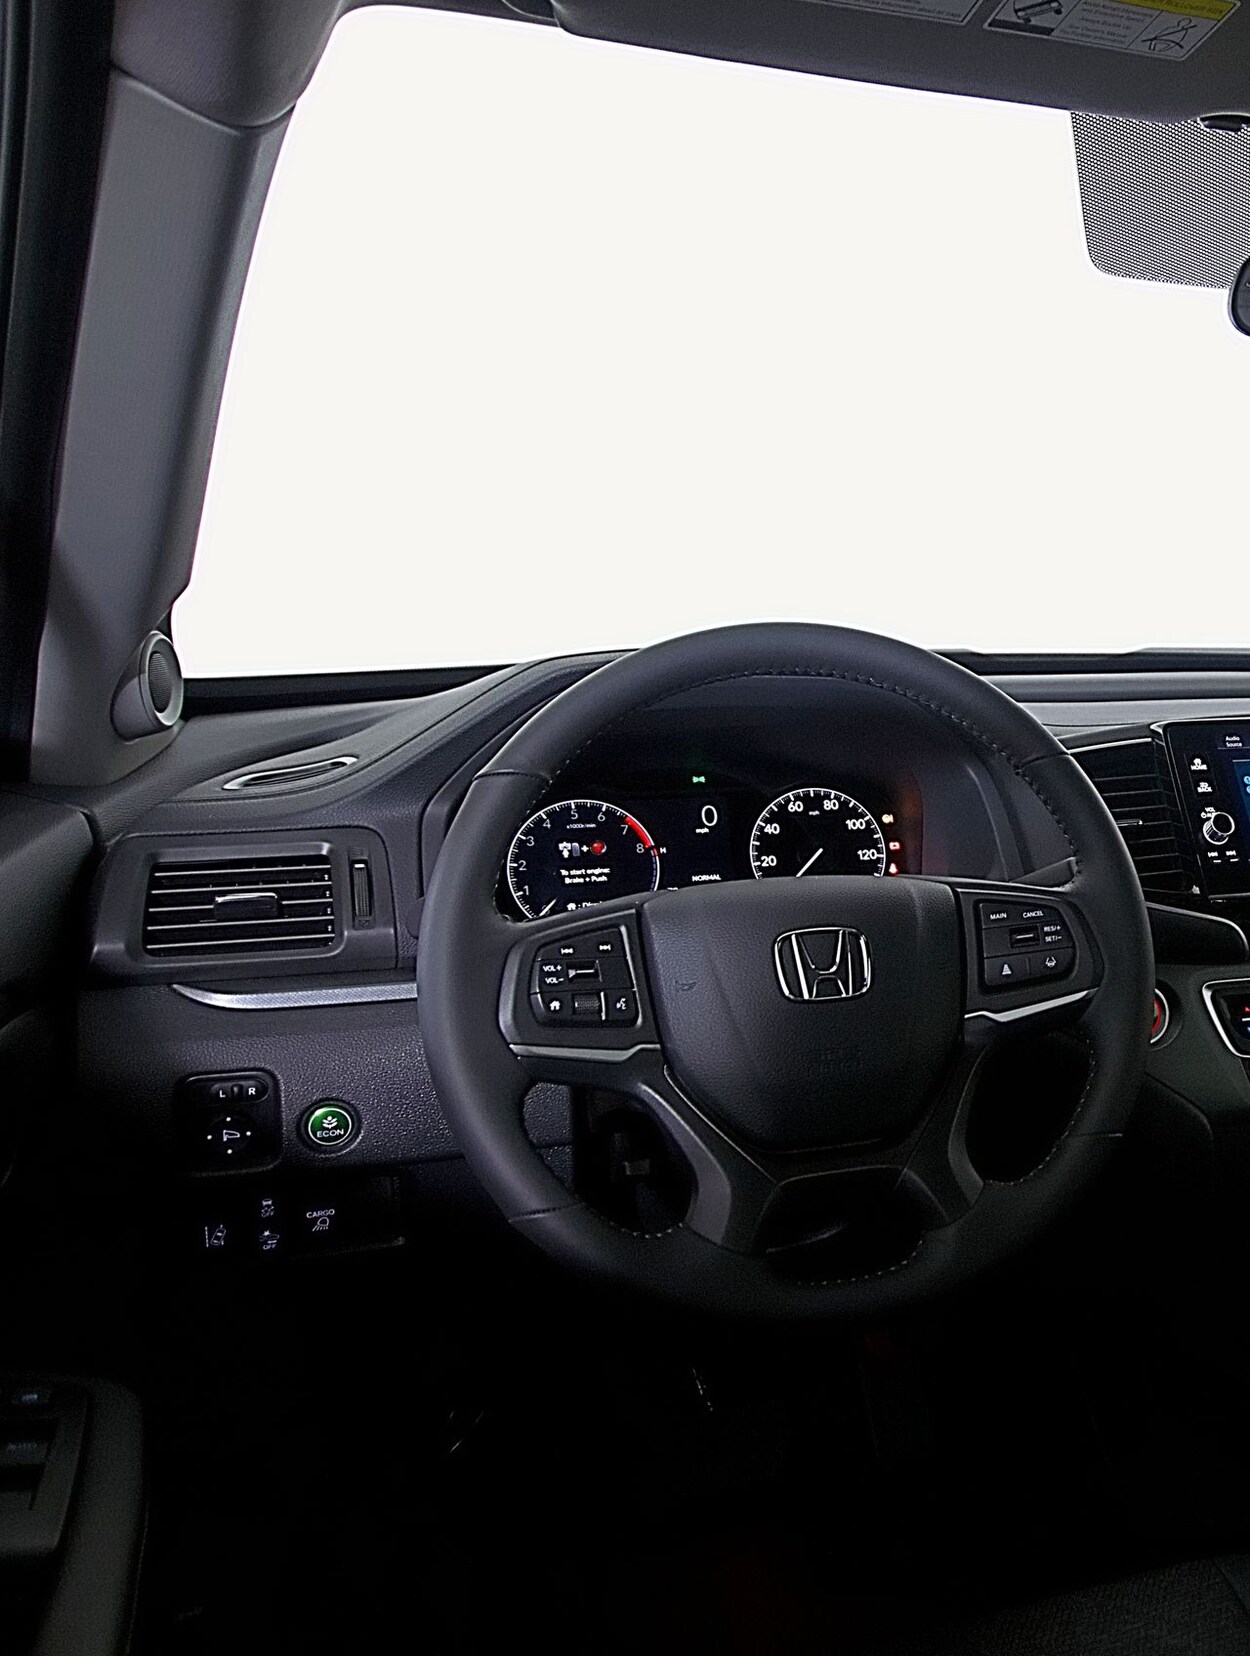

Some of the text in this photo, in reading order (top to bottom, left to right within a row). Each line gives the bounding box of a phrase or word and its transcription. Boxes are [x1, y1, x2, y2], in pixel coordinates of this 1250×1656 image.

[787, 801, 804, 813] 60
[823, 799, 840, 811] 80
[571, 810, 579, 820] 5
[597, 812, 606, 822] 6
[702, 805, 718, 826] 0
[542, 818, 552, 829] 4
[764, 823, 781, 835] 40
[845, 819, 866, 831] 100
[620, 824, 629, 835] 7
[526, 836, 535, 847] 3
[635, 843, 645, 854] 8
[857, 849, 878, 861] 120
[518, 860, 528, 871] 2
[761, 855, 777, 867] 20
[559, 867, 611, 877] To start engine:
[692, 873, 722, 882] NORMAL
[564, 877, 584, 885] Brake
[591, 875, 608, 883] Push
[523, 884, 530, 896] 1
[990, 911, 1008, 920] MAIN
[1022, 910, 1045, 919] CANCEL
[219, 1089, 226, 1098] L
[248, 1086, 257, 1096] R
[316, 1128, 345, 1139] ECON
[306, 1208, 336, 1219] CARGO
[262, 1243, 277, 1251] OFF
